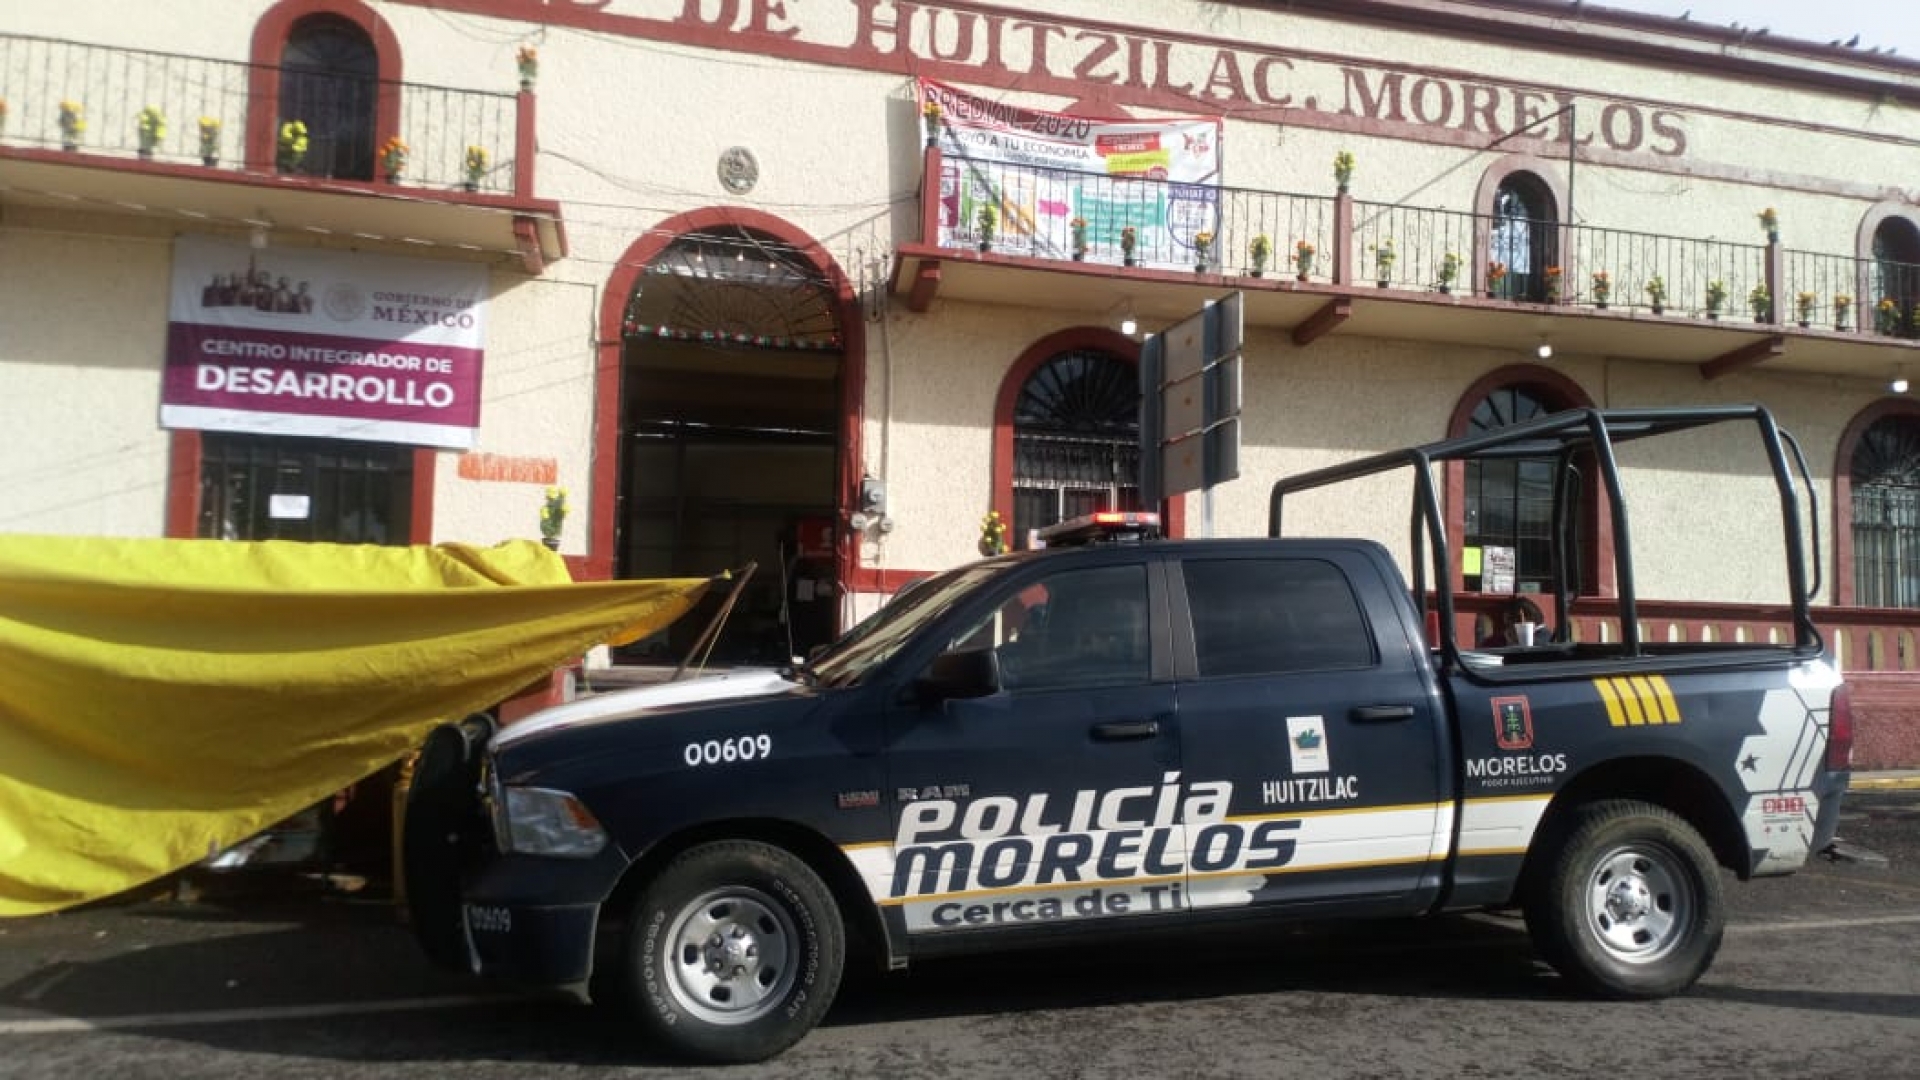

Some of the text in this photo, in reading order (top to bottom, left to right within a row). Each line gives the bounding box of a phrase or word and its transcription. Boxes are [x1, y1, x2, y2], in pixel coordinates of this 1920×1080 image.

[1032, 113, 1090, 140] 2020
[1338, 67, 1687, 157] MORELOS
[1002, 136, 1019, 151] TU
[372, 304, 474, 329] MÉXICO
[202, 339, 453, 374] CENTRO INTEGRADOR DE
[196, 364, 455, 408] DESARROLLO
[684, 733, 772, 767] 00609
[1466, 753, 1567, 777] MORELOS
[1262, 775, 1359, 804] HUITZILAC
[931, 882, 1182, 926] Cerca de Ti
